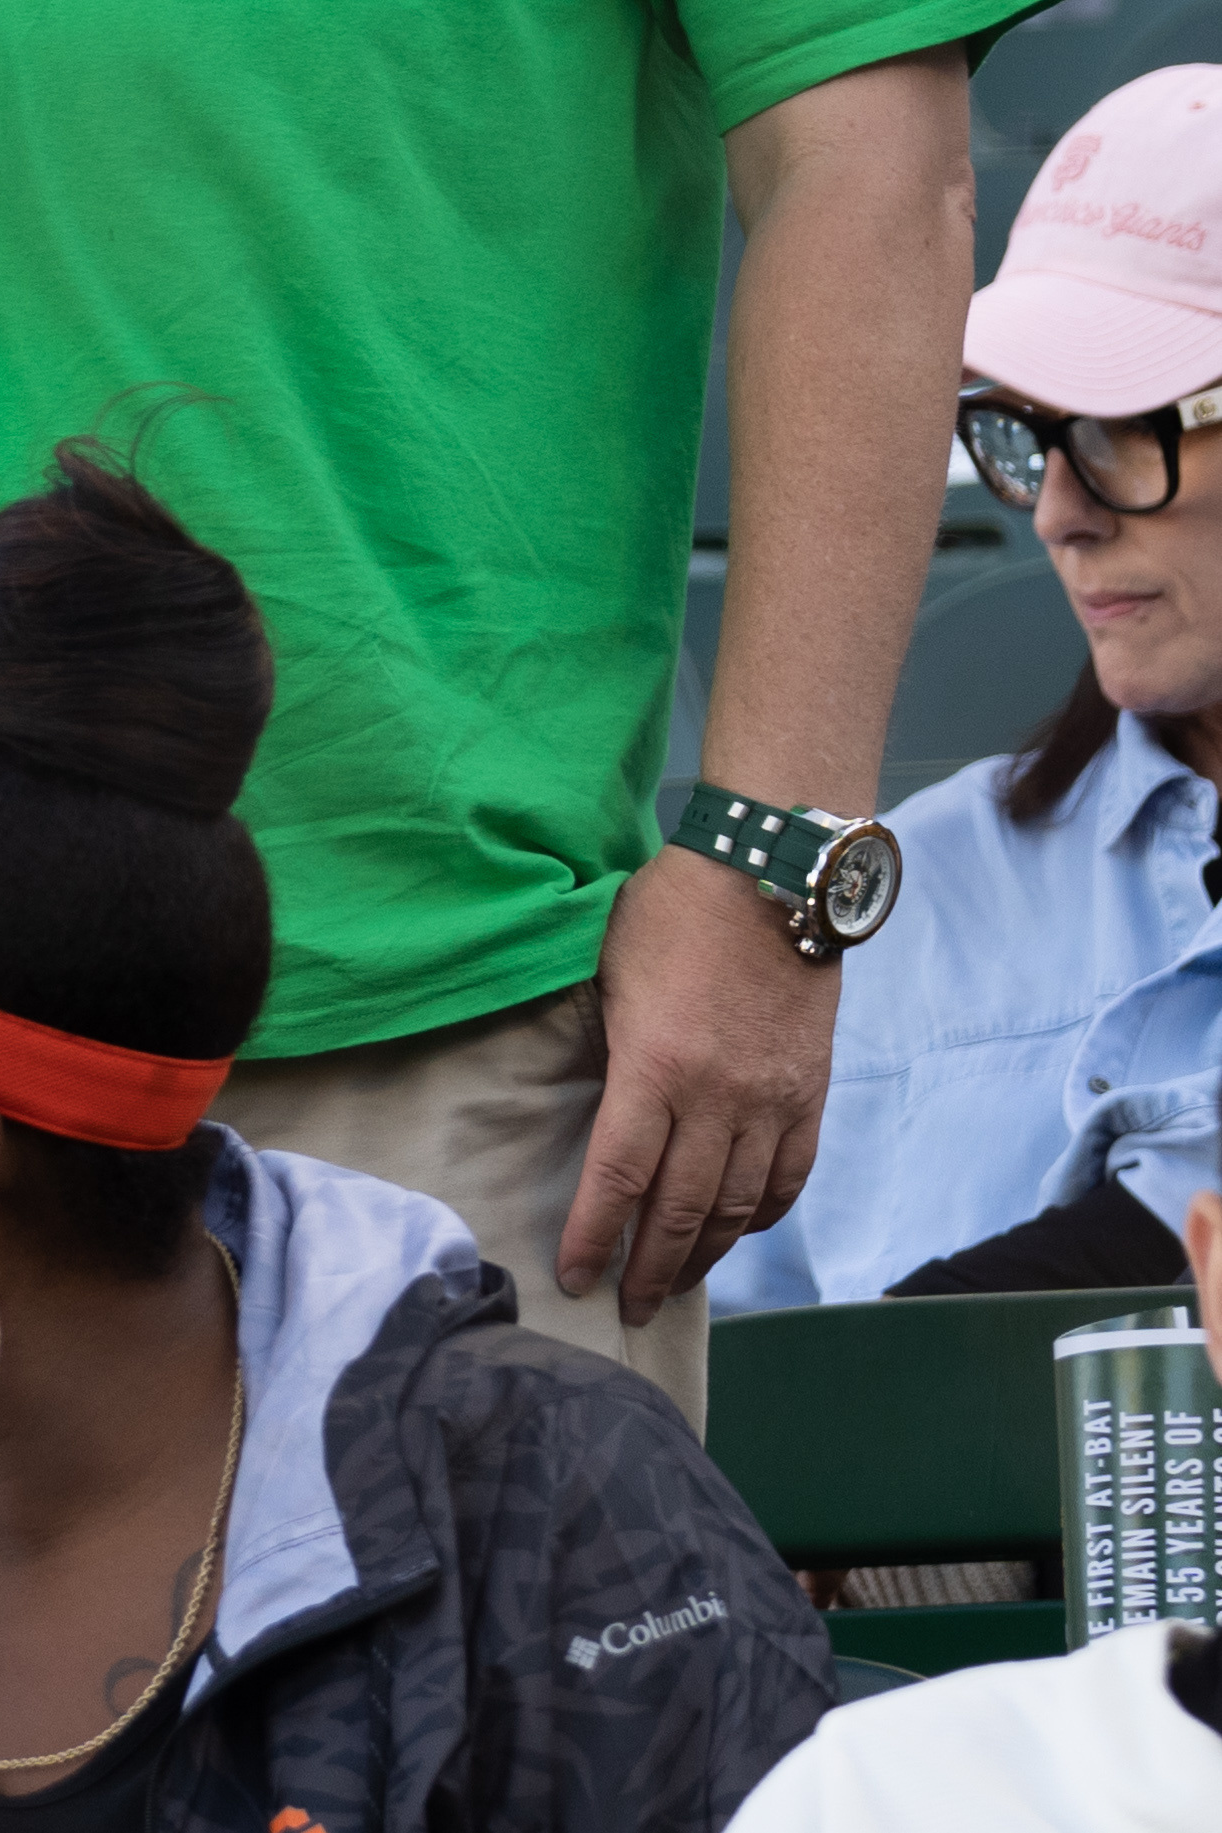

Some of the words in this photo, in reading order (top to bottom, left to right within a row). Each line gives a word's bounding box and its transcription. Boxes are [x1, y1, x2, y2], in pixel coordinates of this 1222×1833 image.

[1083, 1399, 1113, 1508] AT-BAT
[1119, 1411, 1156, 1516] SILENT
[1163, 1410, 1203, 1446] OF
[1164, 1457, 1205, 1555] YEARS
[1086, 1522, 1115, 1607] FIRST
[1121, 1528, 1157, 1625] EMAIN
[1165, 1566, 1206, 1603] 55
